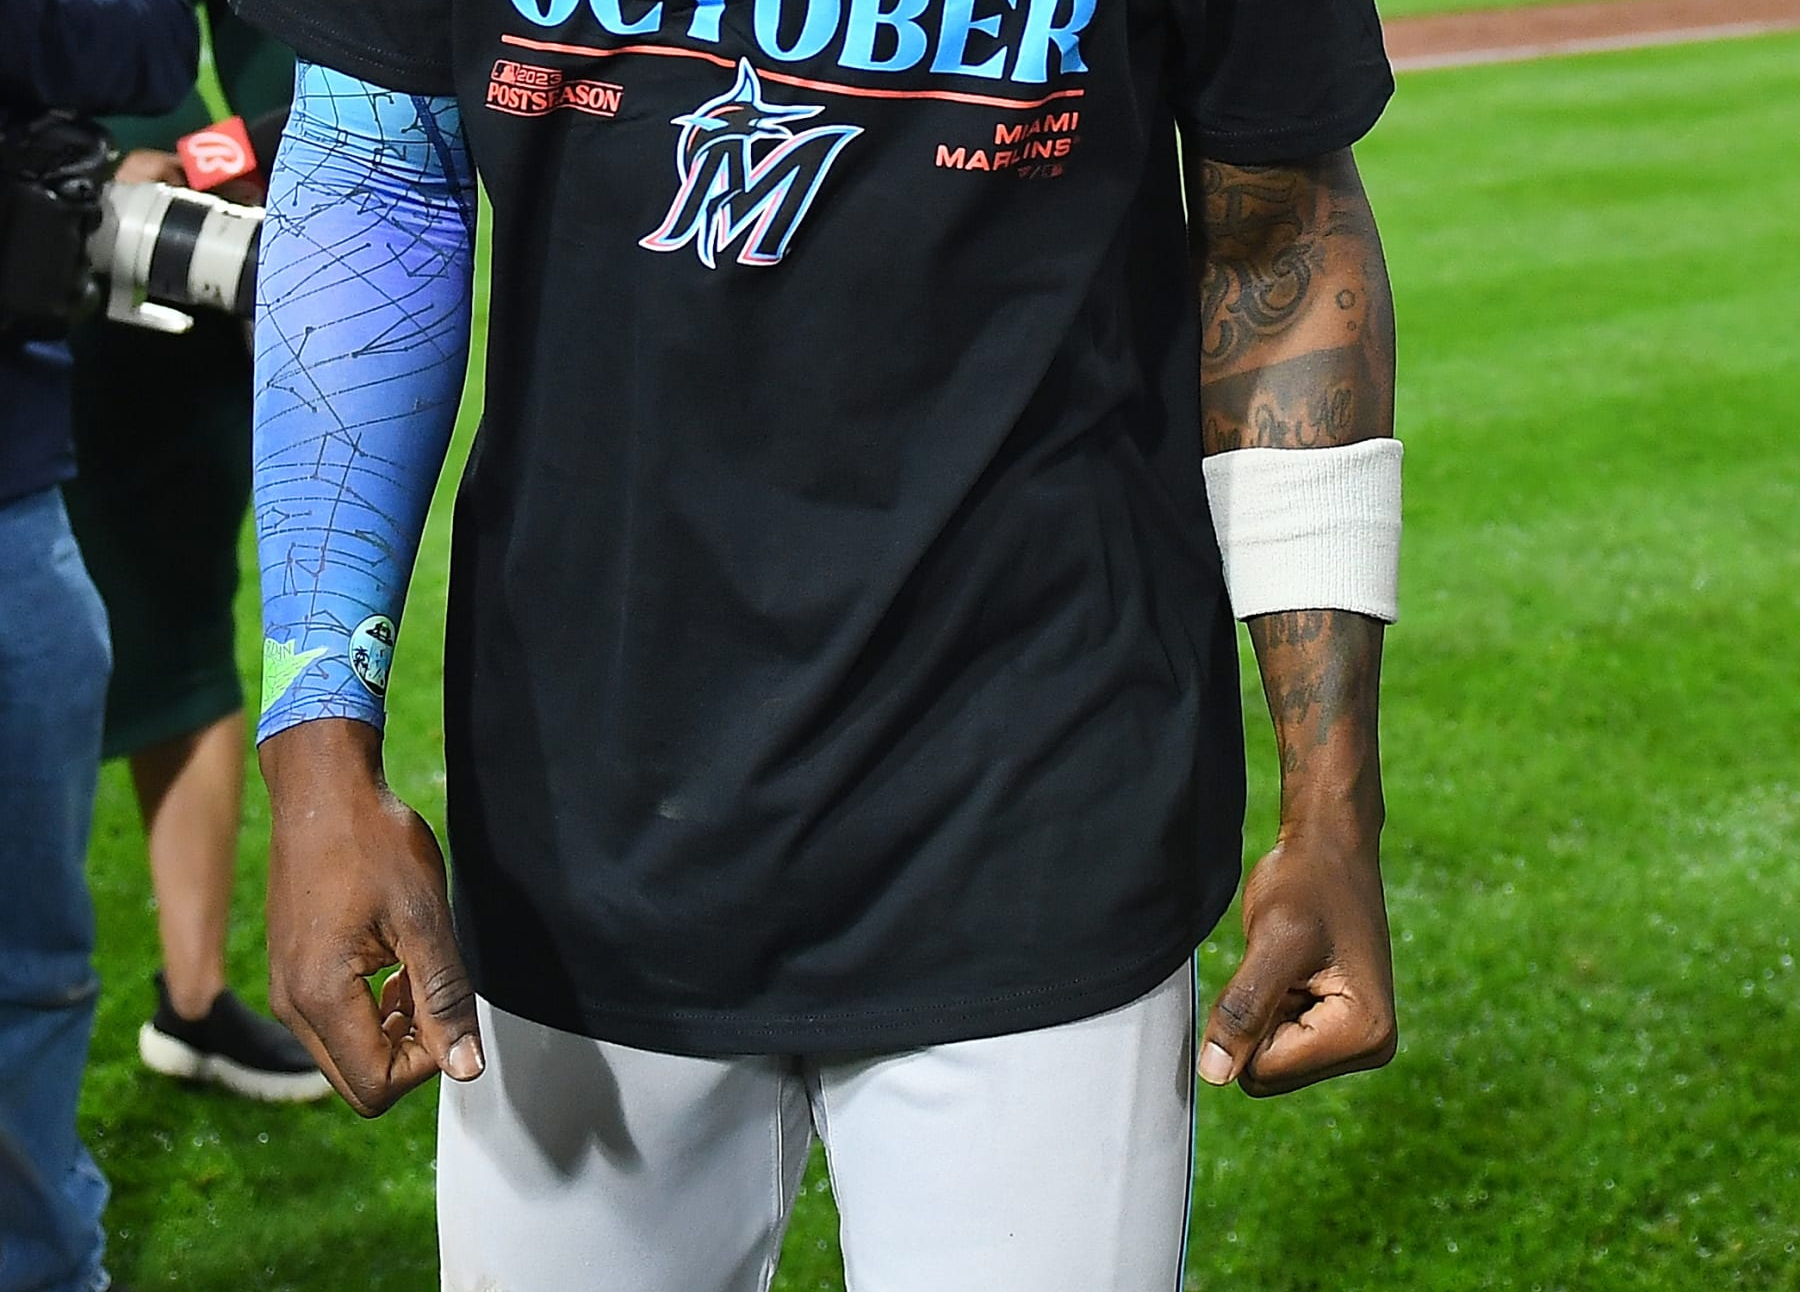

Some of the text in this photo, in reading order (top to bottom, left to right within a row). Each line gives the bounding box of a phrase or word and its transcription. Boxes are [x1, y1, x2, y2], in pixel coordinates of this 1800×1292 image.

[517, 69, 562, 85] 2023
[994, 112, 1079, 145] MIAMI
[934, 138, 1072, 171] MARLINS
